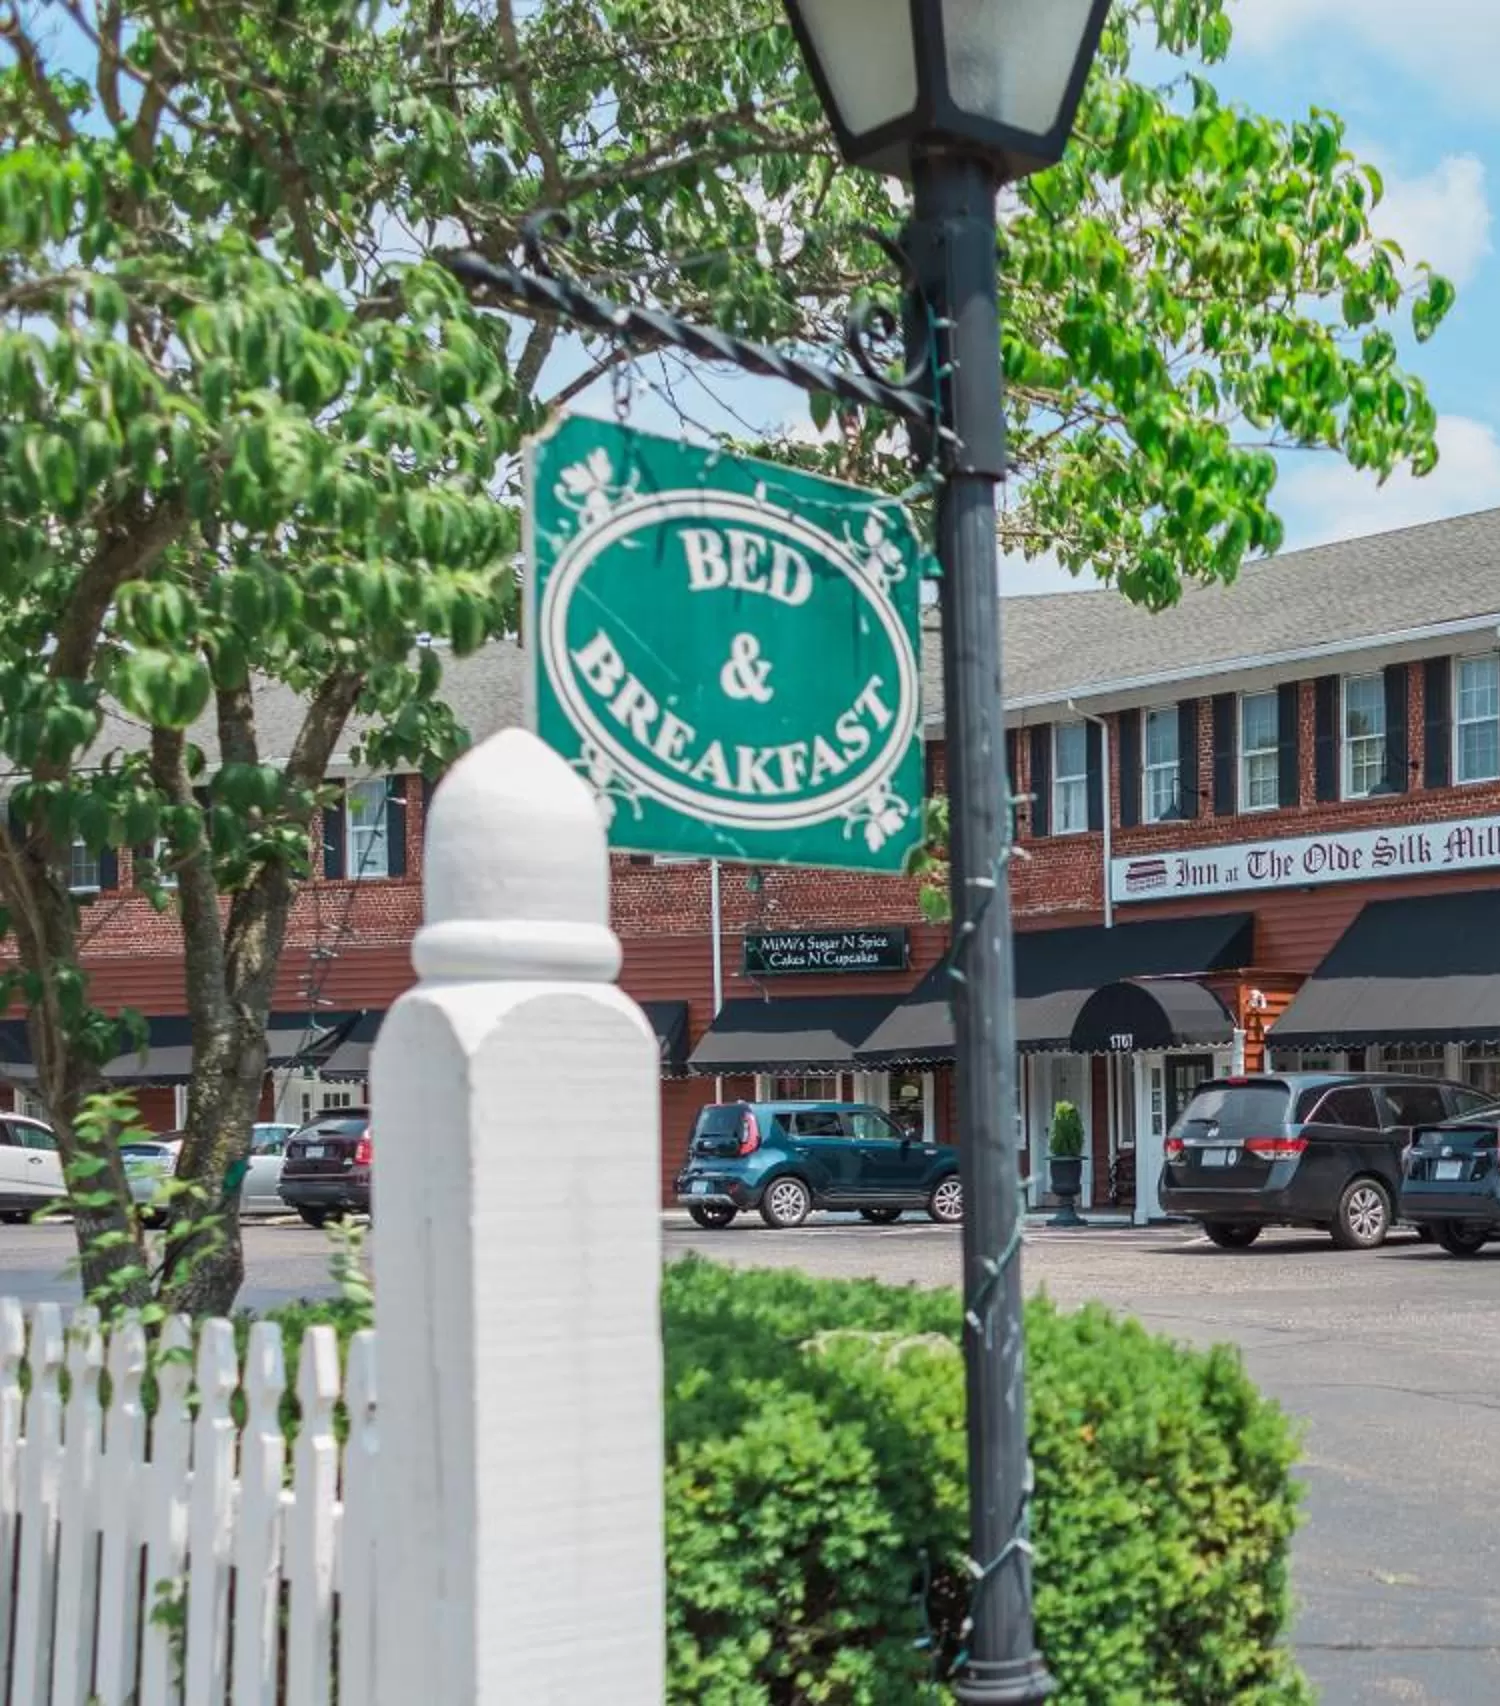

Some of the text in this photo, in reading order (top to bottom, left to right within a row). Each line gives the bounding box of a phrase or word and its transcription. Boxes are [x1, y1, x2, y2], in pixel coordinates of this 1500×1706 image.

[679, 529, 813, 606] BED
[719, 633, 775, 703] &
[571, 628, 893, 795] BREAKFAST
[1175, 858, 1219, 886] Inn
[1225, 867, 1239, 883] at
[1247, 849, 1294, 881] The
[1303, 842, 1363, 874] Olde
[1372, 833, 1432, 868] Silk
[769, 951, 879, 966] Cakes N Cupcakes
[807, 936, 840, 952] Sugar
[843, 935, 855, 950] N
[858, 934, 889, 949] Spice
